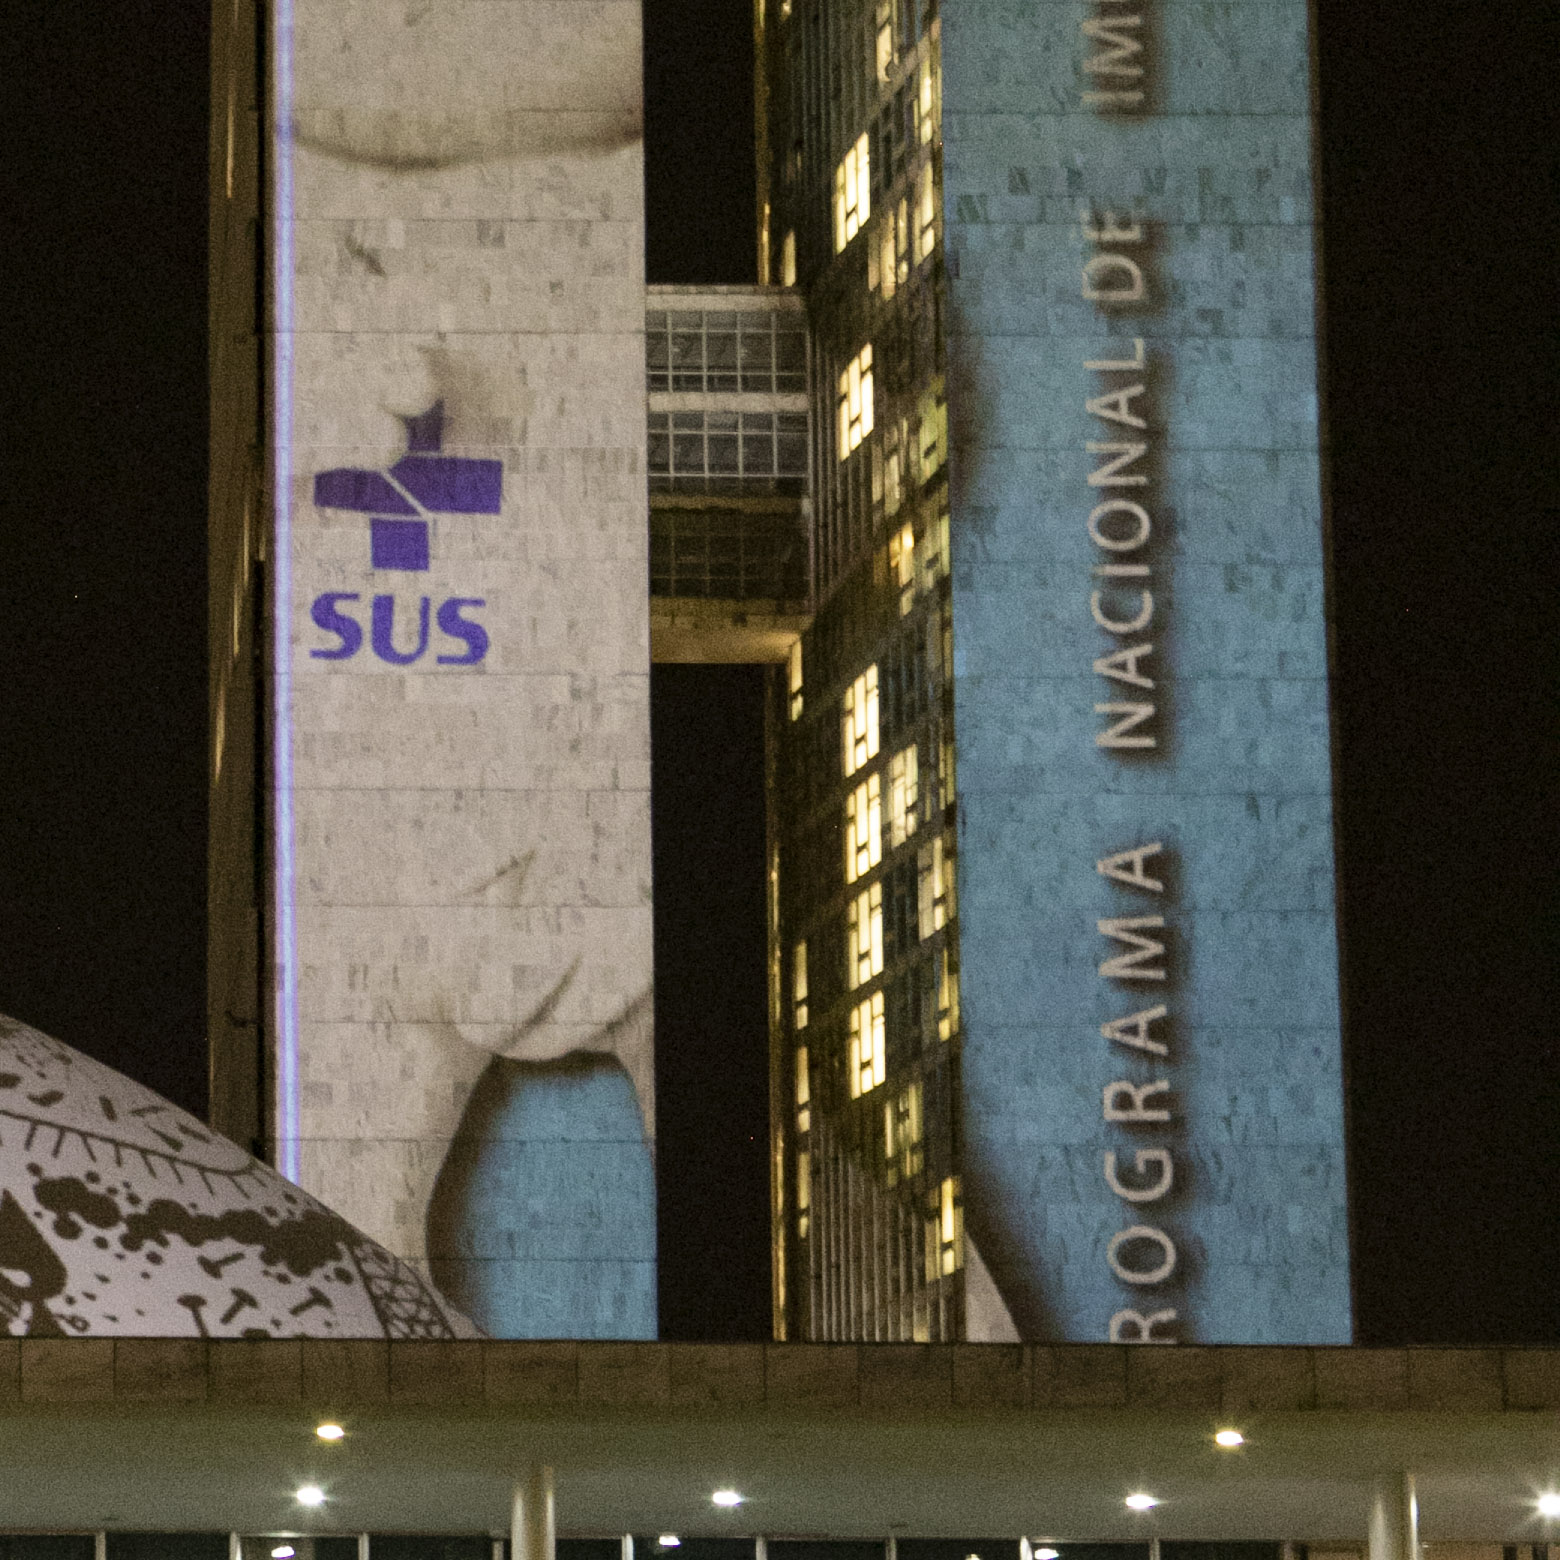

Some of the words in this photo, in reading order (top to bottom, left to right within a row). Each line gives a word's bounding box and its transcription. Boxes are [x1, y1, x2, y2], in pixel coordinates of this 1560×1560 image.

[1080, 207, 1144, 300] DE
[309, 591, 490, 666] SUS
[1083, 339, 1157, 749] NACIONAL
[1097, 842, 1178, 1344] ROGRAMA
